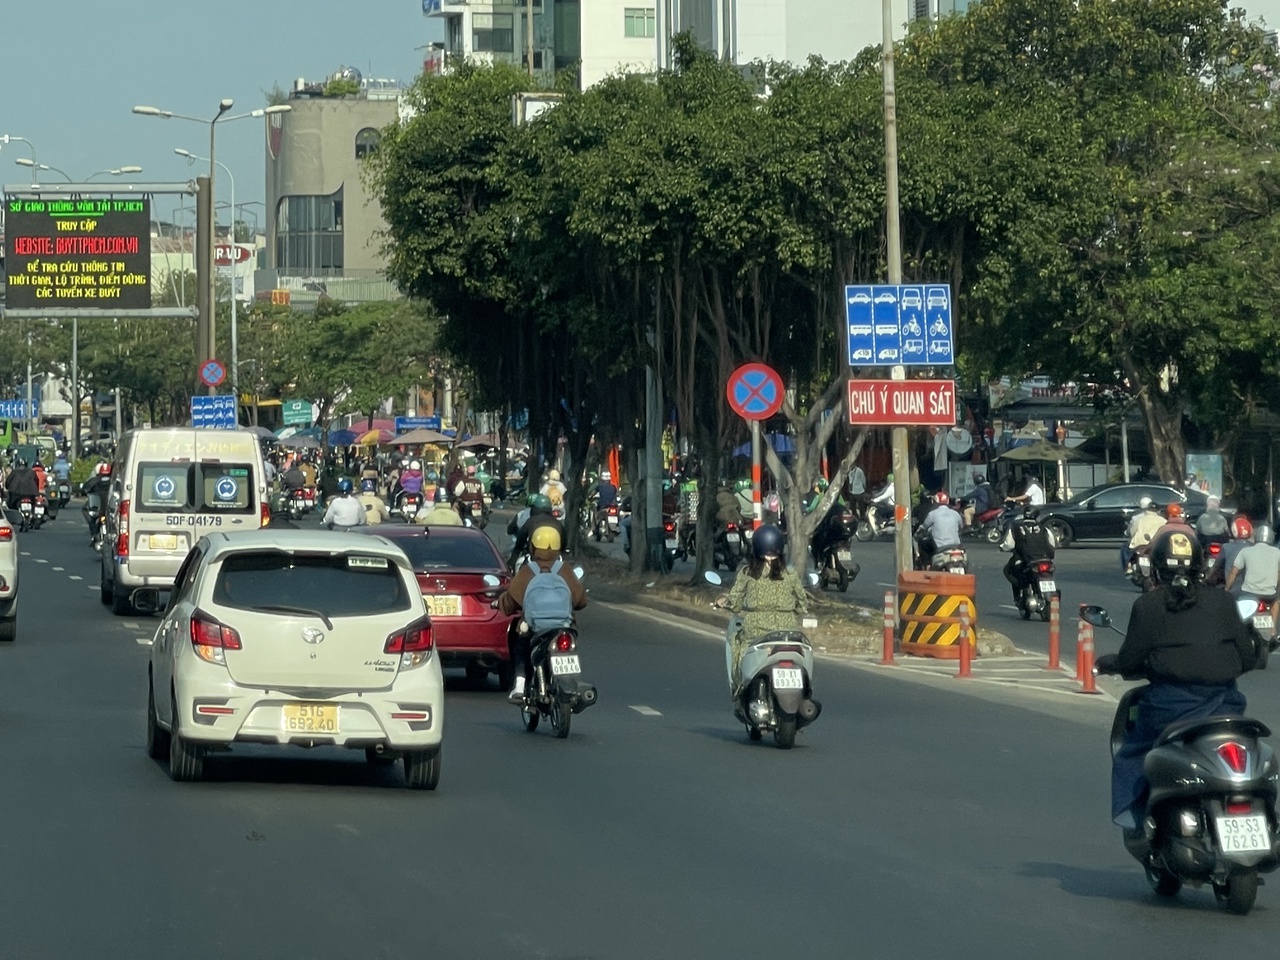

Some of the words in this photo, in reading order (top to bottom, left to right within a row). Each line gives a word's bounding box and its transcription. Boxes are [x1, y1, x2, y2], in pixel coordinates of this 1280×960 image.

[25, 202, 45, 212] GIAO
[48, 200, 74, 212] THÔNG
[56, 221, 78, 231] TRUY
[80, 219, 98, 232] CẬP
[15, 237, 54, 254] WEBSITE:
[42, 263, 58, 273] TRA
[60, 261, 78, 273] CỨU
[81, 260, 108, 273] THÔNG
[111, 262, 125, 272] TIN
[36, 287, 52, 298] CÁC
[84, 288, 97, 298] XE
[851, 385, 875, 414] CHÚ
[880, 385, 888, 414] Ý
[893, 391, 925, 415] QUAN
[929, 385, 951, 415] SÁT
[299, 706, 324, 717] 51G
[289, 718, 334, 731] 692.40
[1224, 818, 1261, 834] 59-S3
